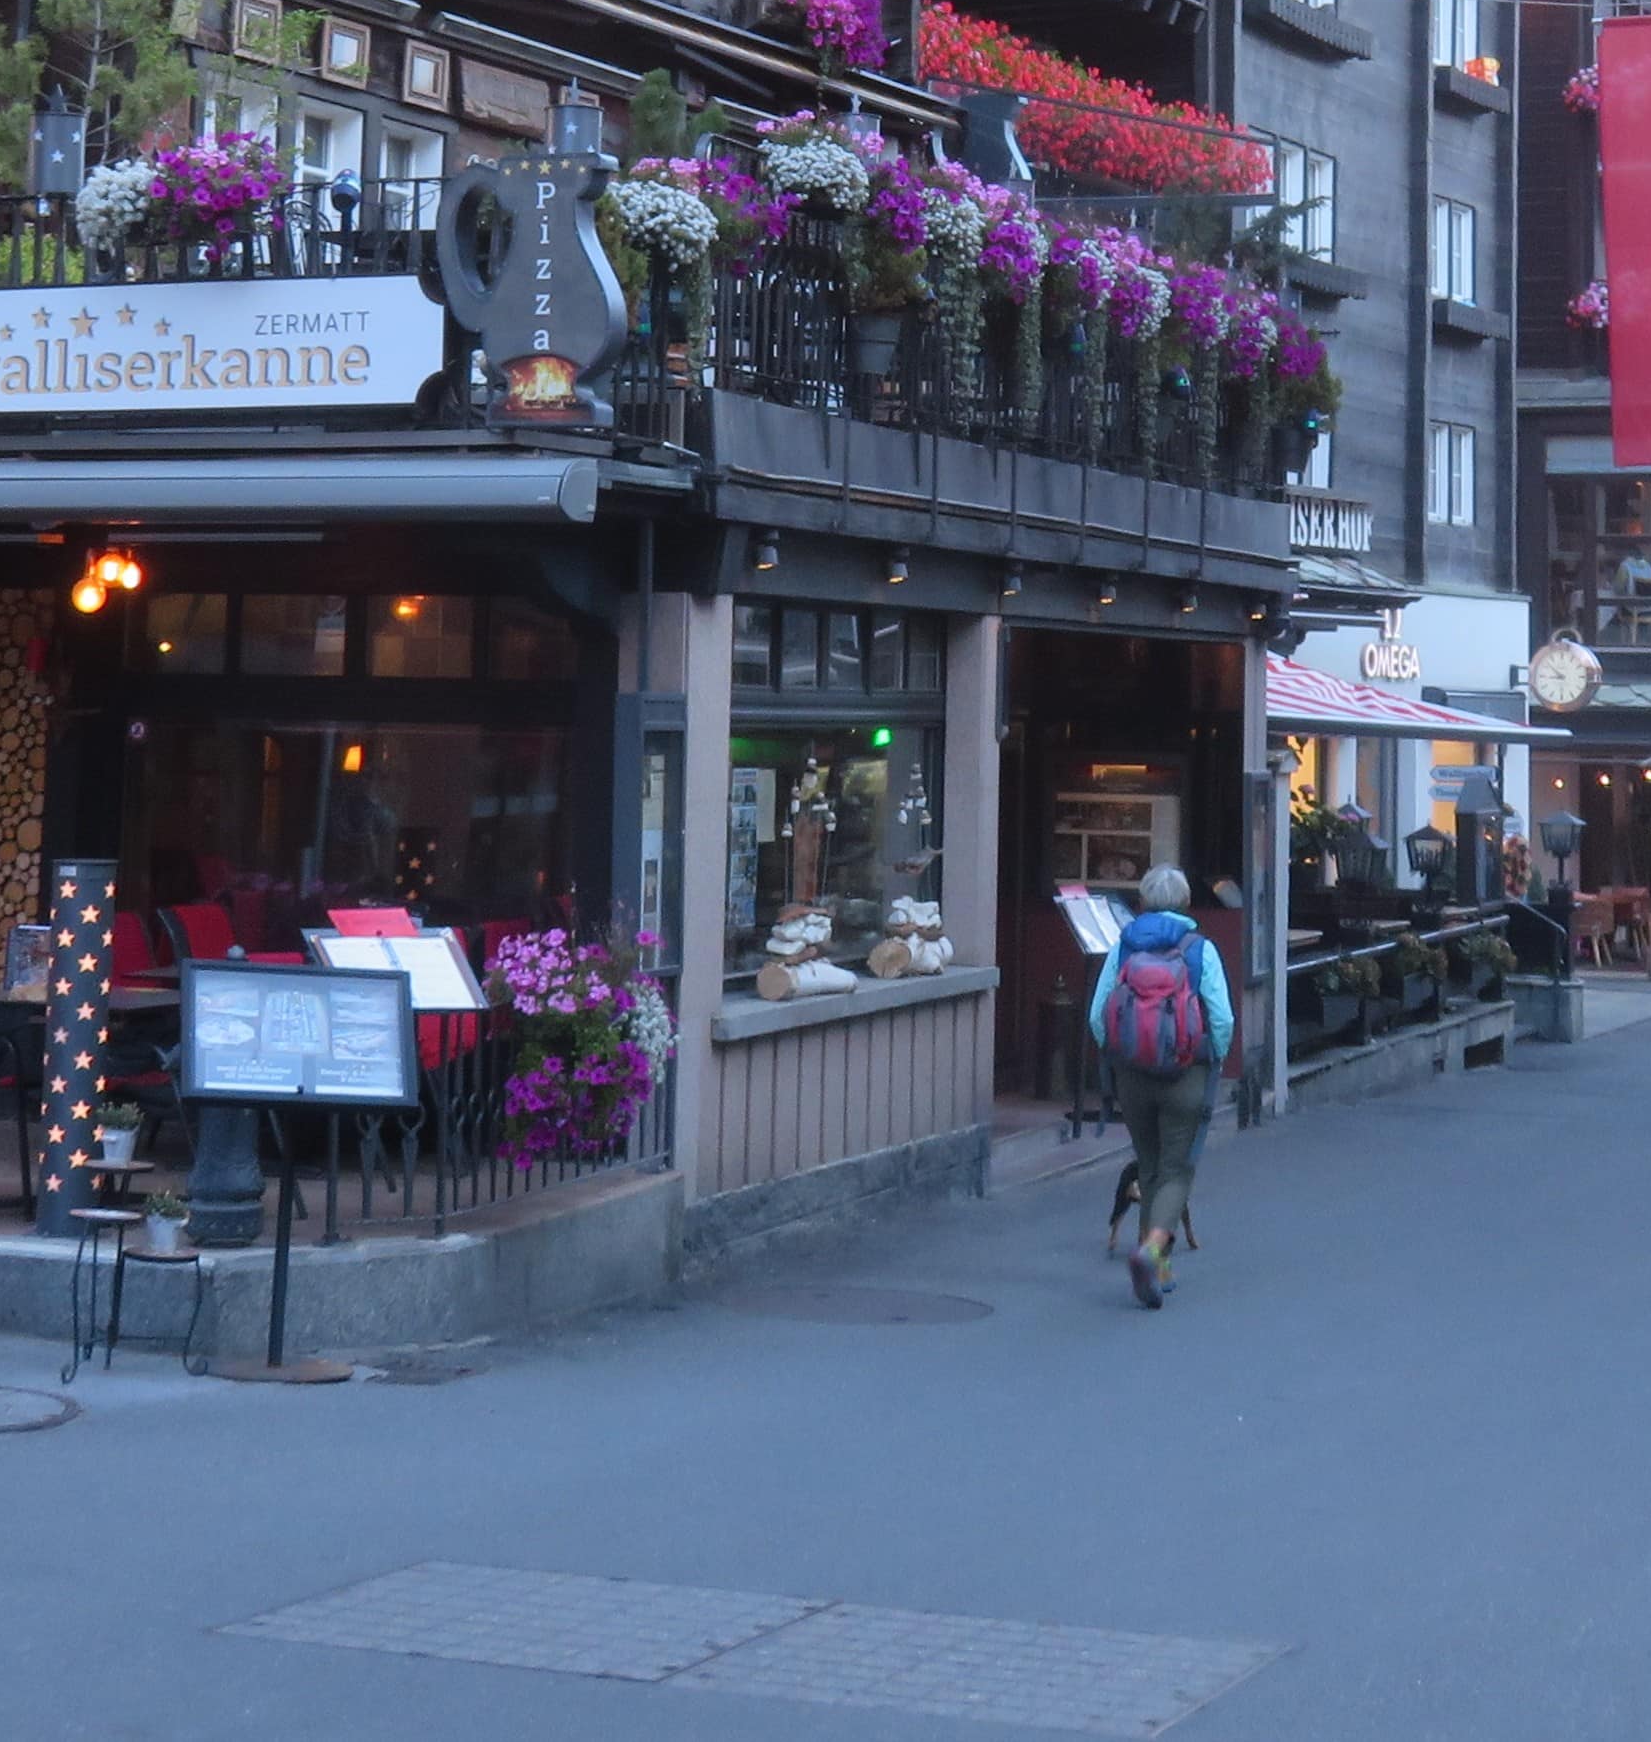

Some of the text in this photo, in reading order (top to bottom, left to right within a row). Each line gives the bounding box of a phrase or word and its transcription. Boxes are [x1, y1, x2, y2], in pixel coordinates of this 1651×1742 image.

[532, 181, 556, 351] Pizza
[253, 311, 371, 337] ZERMATT
[1364, 642, 1421, 679] OMEGA
